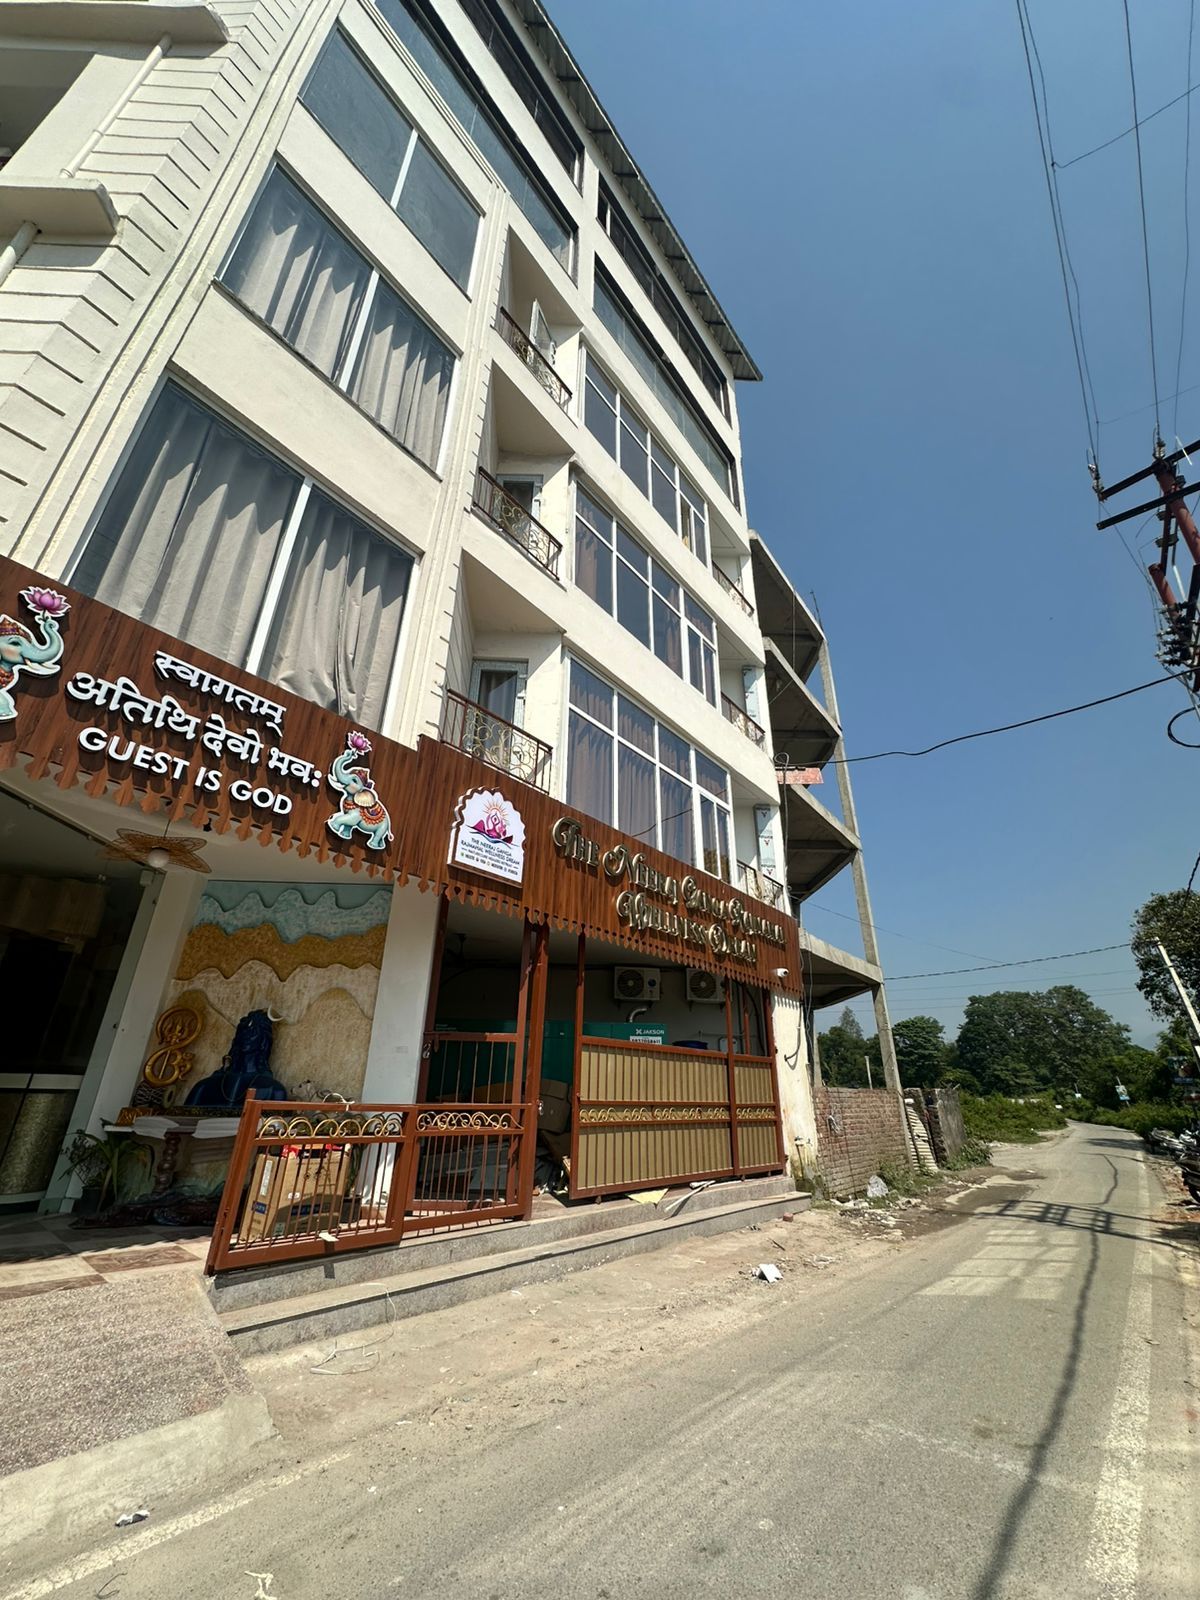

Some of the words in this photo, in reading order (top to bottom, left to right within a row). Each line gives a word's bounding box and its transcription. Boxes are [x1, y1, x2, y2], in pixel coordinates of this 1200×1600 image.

[65, 671, 201, 740] अतिथि
[201, 714, 264, 765] देवो
[154, 650, 287, 737] स्वागतम्
[78, 726, 191, 781] GUEST
[194, 759, 223, 791] IS
[229, 779, 293, 816] GOD
